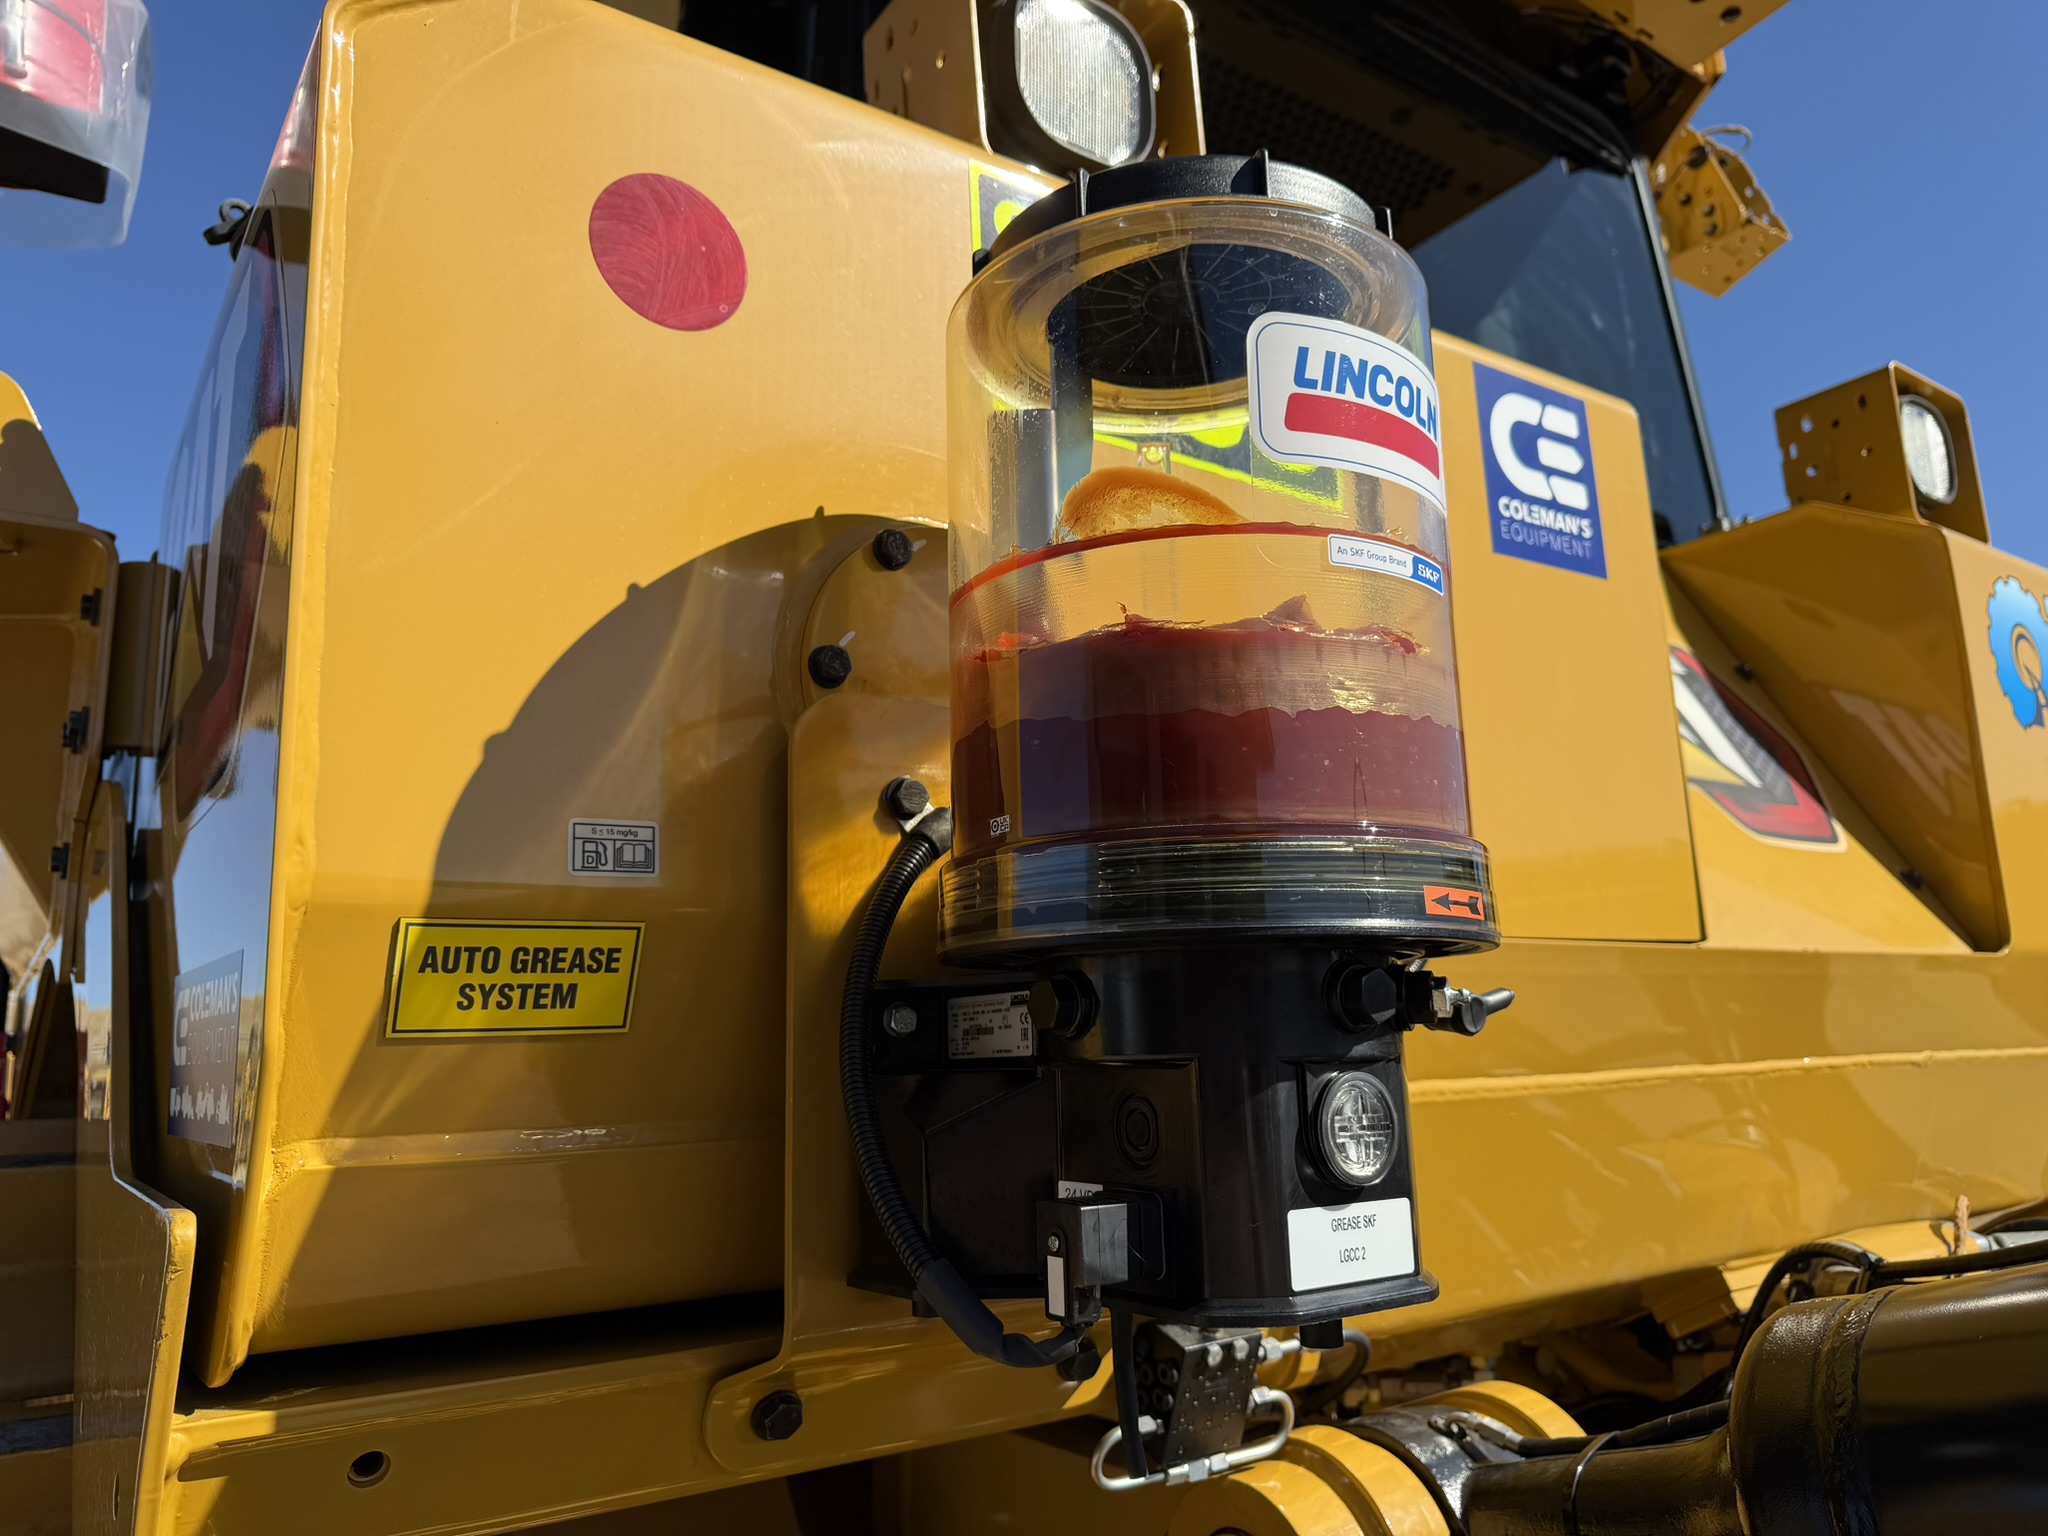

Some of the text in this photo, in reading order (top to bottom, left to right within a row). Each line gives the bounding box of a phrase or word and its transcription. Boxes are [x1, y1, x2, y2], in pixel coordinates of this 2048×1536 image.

[1294, 346, 1437, 441] LINCOLN
[1498, 495, 1594, 540] COLEMAN'S
[1499, 518, 1593, 559] EQUIPMENT
[1337, 546, 1408, 568] An SKF Group Brand
[1418, 563, 1440, 584] SKF
[591, 827, 597, 835] S
[606, 828, 615, 836] 15
[616, 829, 639, 838] mg/kg
[586, 855, 595, 865] D
[418, 946, 622, 974] AUTO GREASE
[190, 971, 239, 1022] COLEMAN'S
[456, 982, 578, 1011] SYSTEM
[1331, 1214, 1377, 1232] GREASE SKF
[1339, 1246, 1366, 1263] LGCC 2
